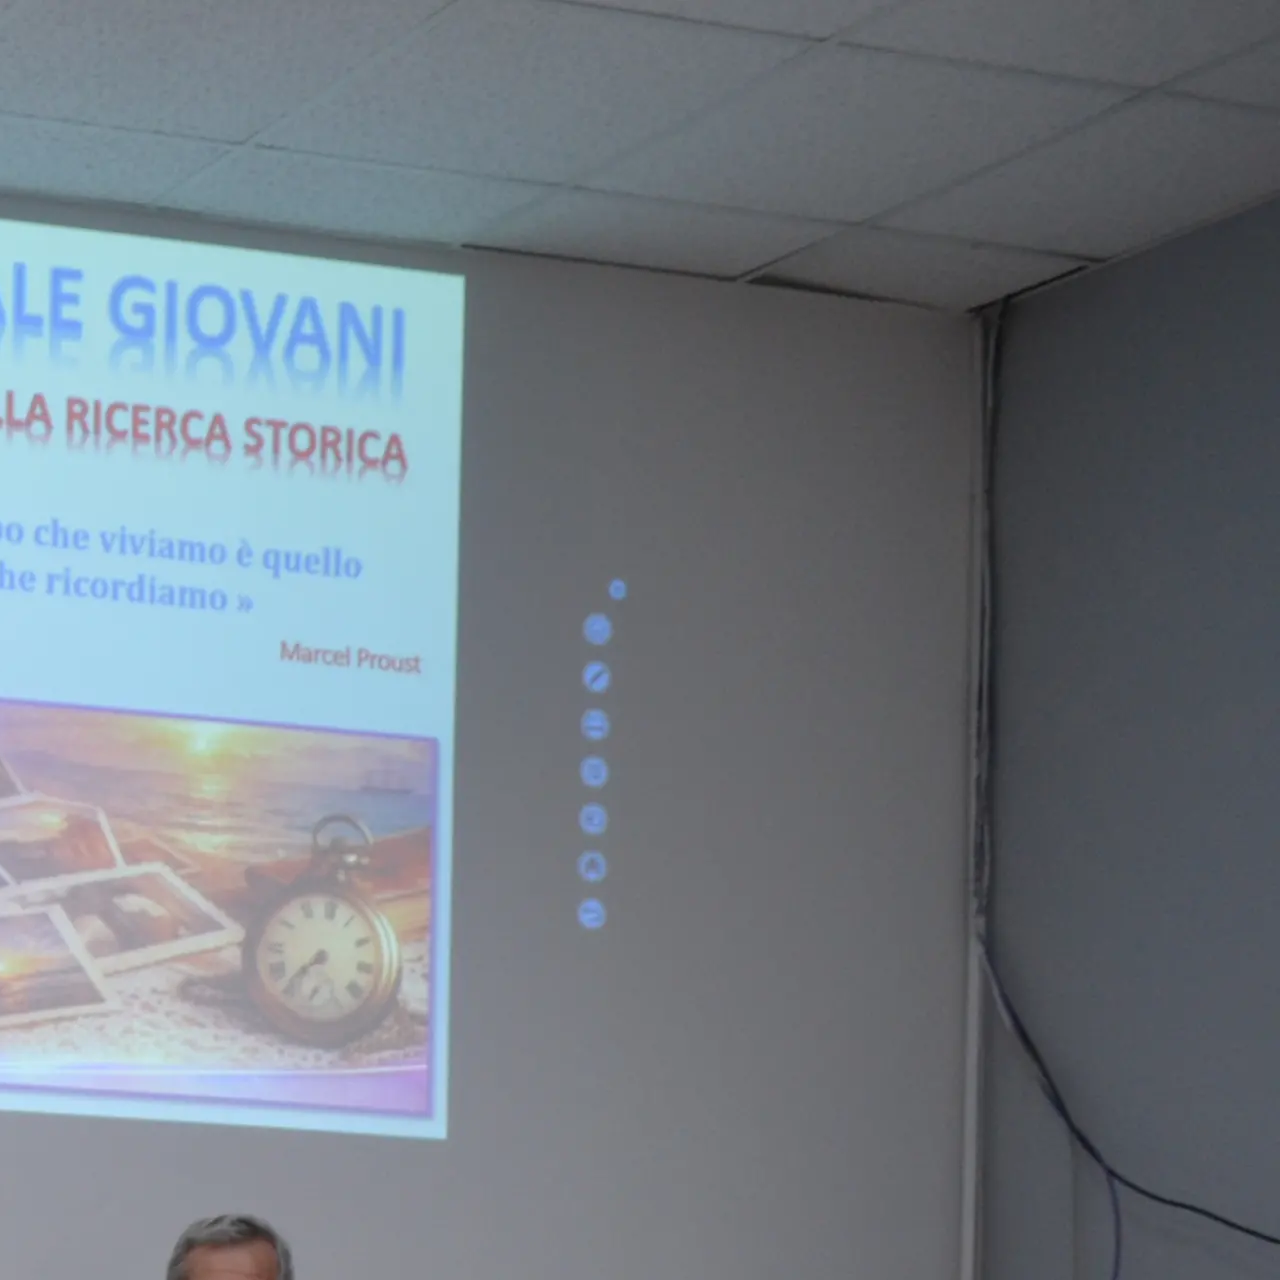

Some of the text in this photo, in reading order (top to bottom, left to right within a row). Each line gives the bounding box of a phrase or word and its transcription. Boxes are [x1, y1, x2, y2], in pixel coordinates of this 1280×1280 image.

[108, 274, 406, 374] GIOVANI
[65, 396, 232, 451] RICERCA
[243, 416, 409, 471] STORICA
[33, 517, 90, 552] che
[98, 524, 228, 566] viviamo
[236, 538, 253, 568] è
[262, 545, 364, 580] quello
[45, 566, 228, 612] ricordiamo
[279, 639, 422, 674] Marcel Proust
